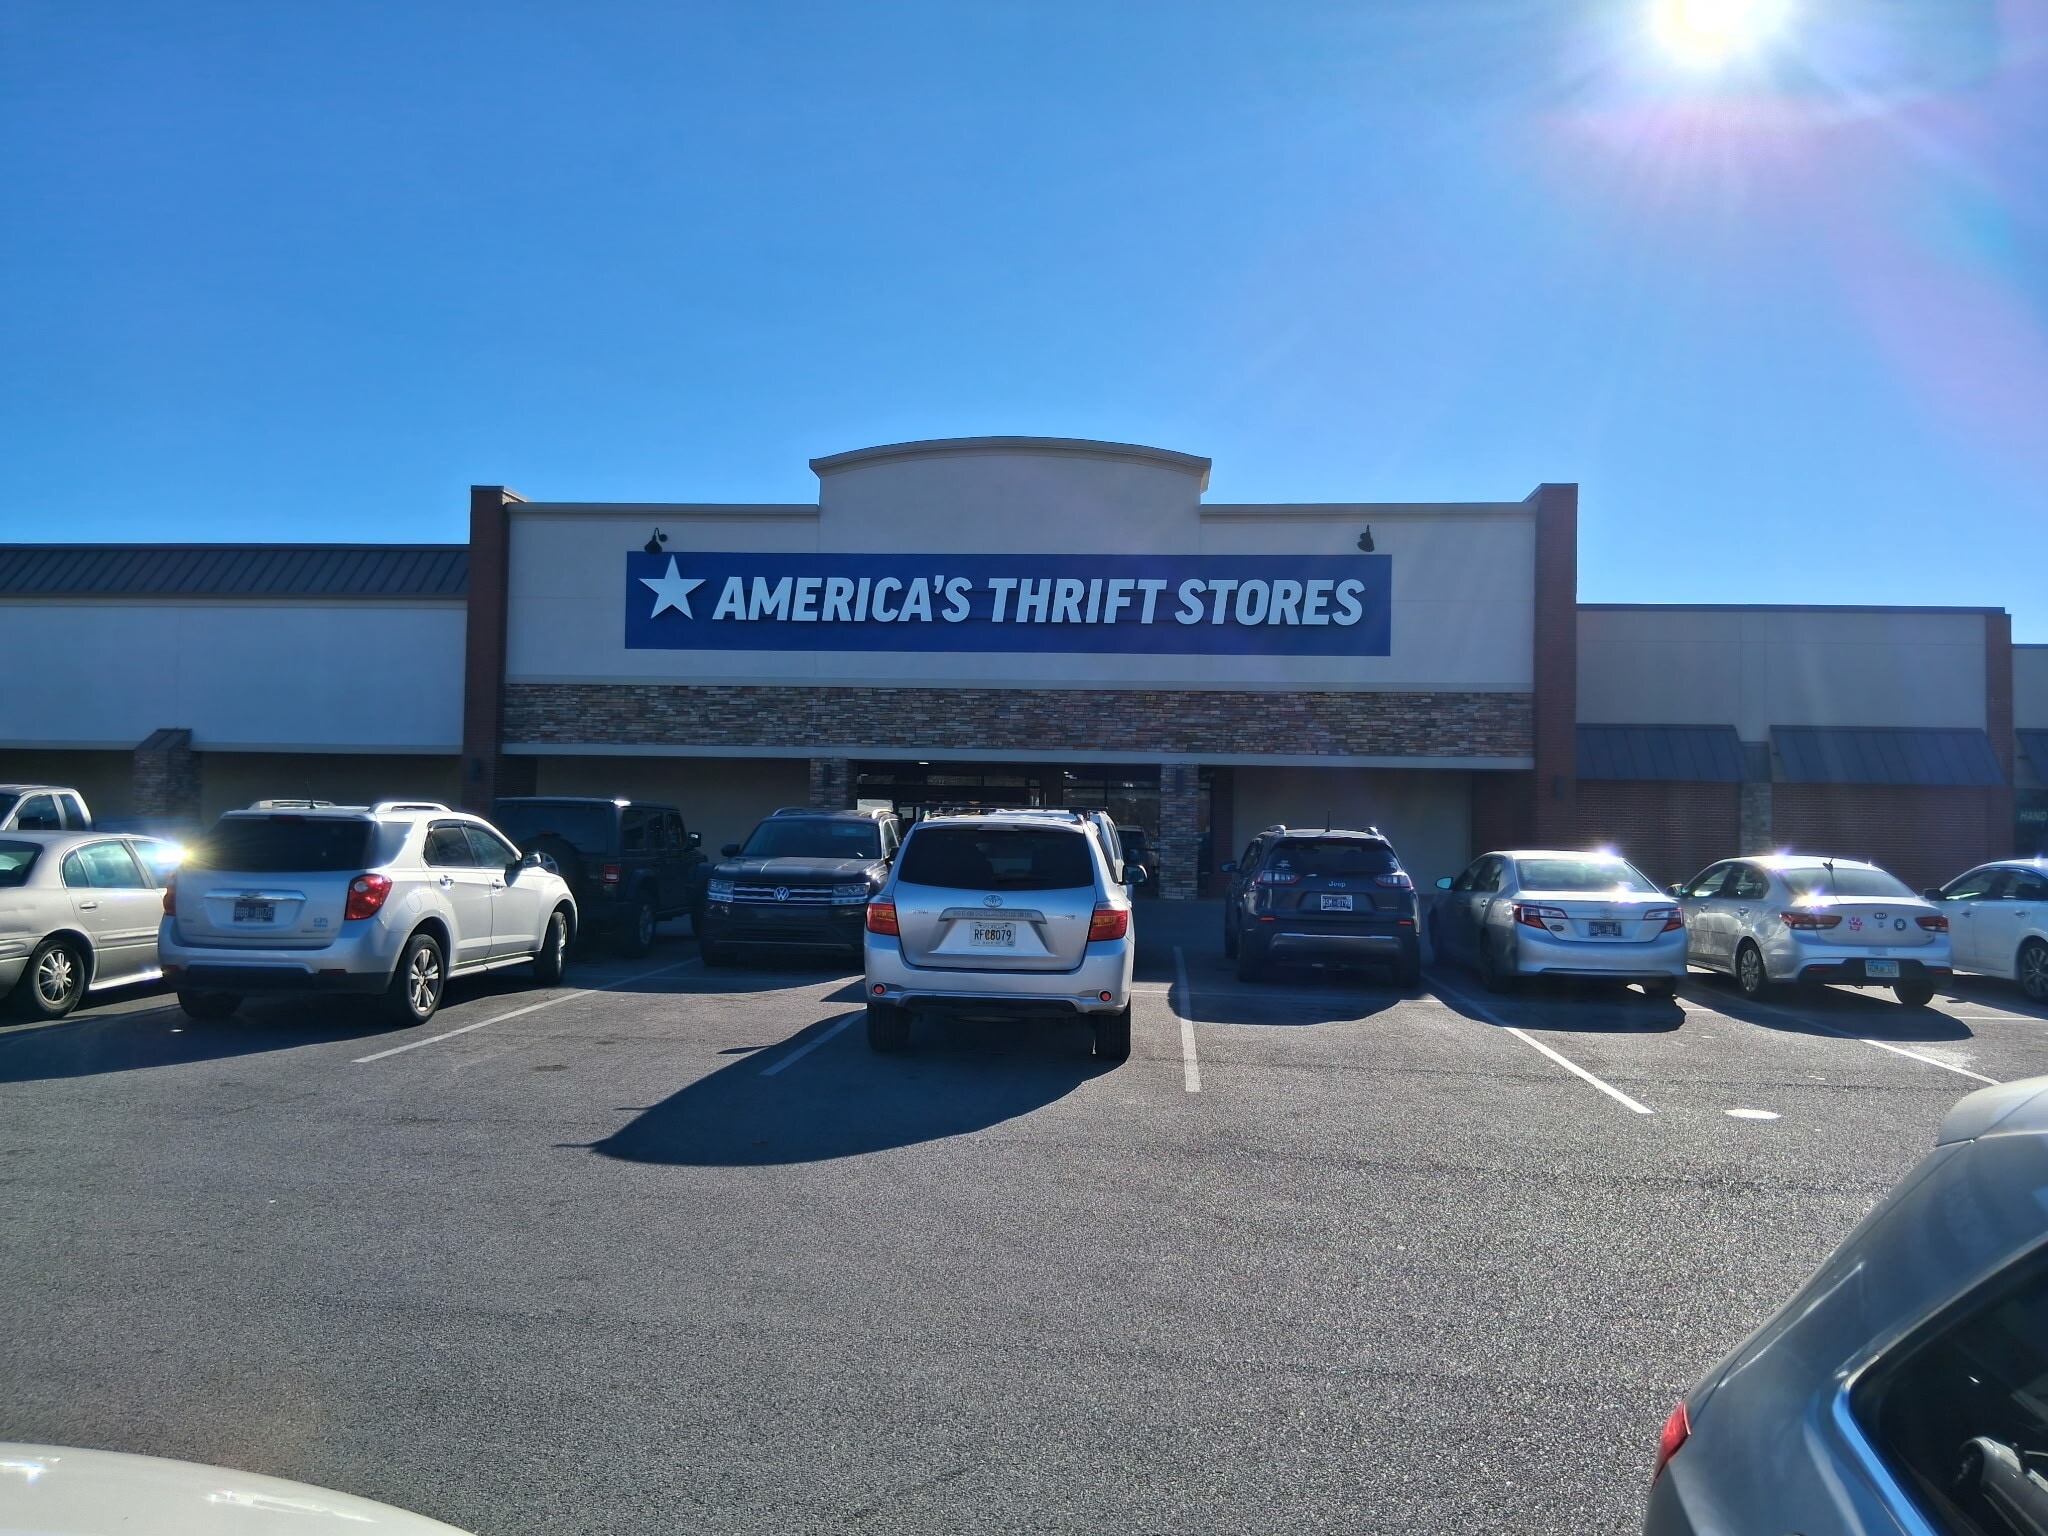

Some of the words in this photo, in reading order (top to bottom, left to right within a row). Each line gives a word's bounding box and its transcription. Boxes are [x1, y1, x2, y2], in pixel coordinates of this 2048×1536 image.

[711, 575, 973, 623] AMERICA'S
[988, 577, 1168, 625] THRIFT
[1174, 578, 1365, 627] STORES
